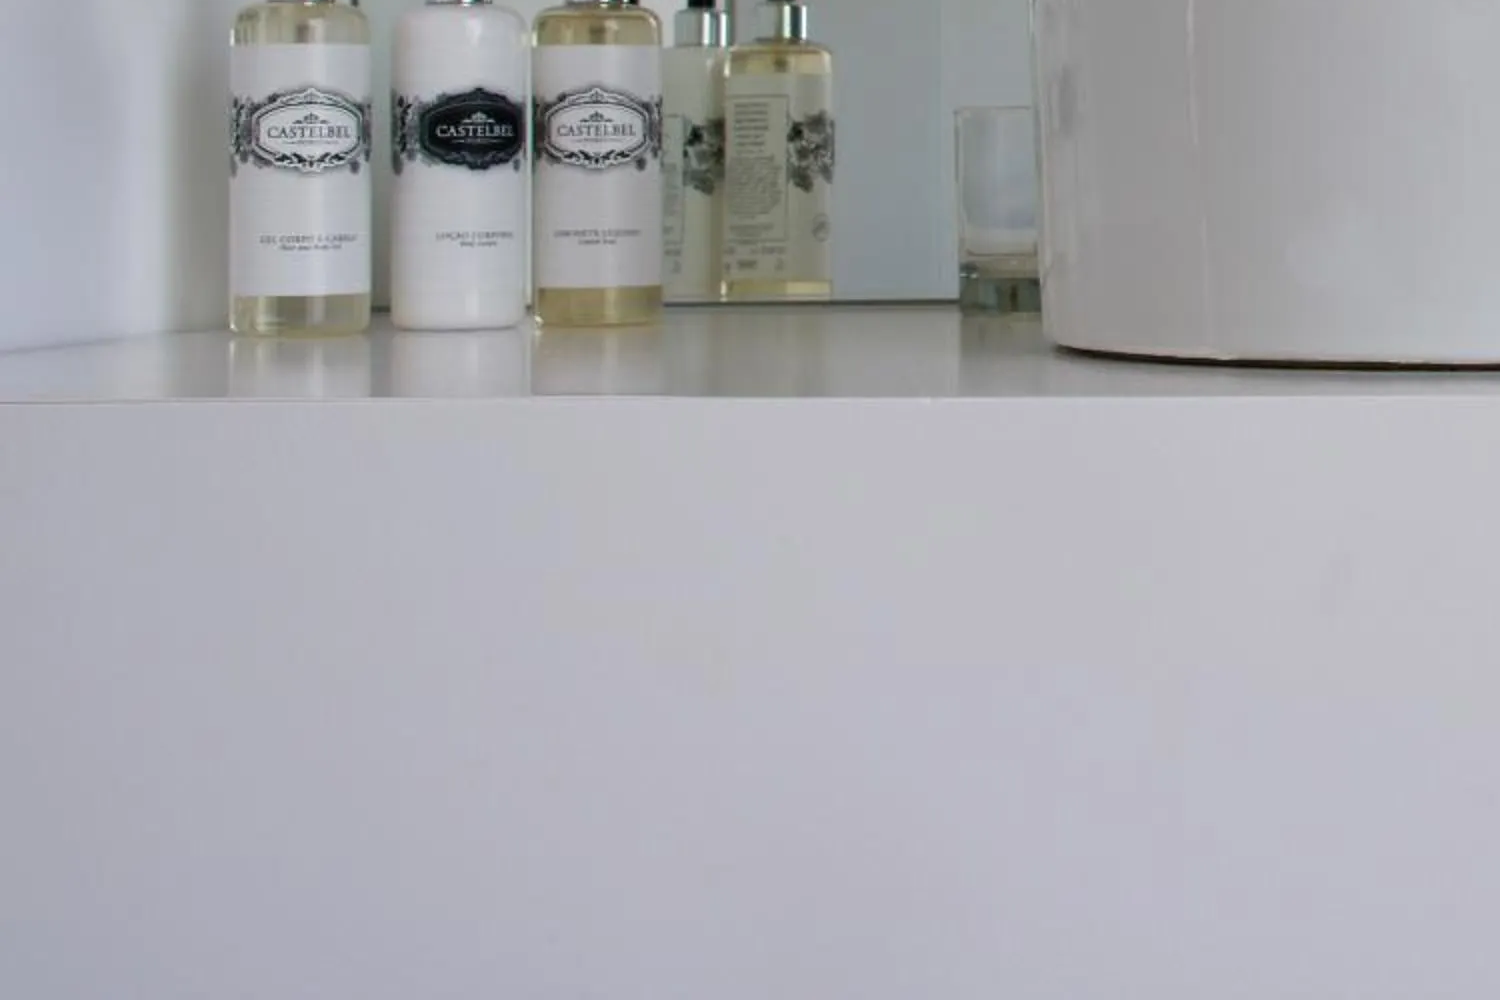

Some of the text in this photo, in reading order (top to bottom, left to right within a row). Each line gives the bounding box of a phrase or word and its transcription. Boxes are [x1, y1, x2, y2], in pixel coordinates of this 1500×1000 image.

[267, 125, 352, 139] CASTELBEL
[435, 124, 515, 138] CASTELBEL
[556, 123, 637, 137] CASTELBEL
